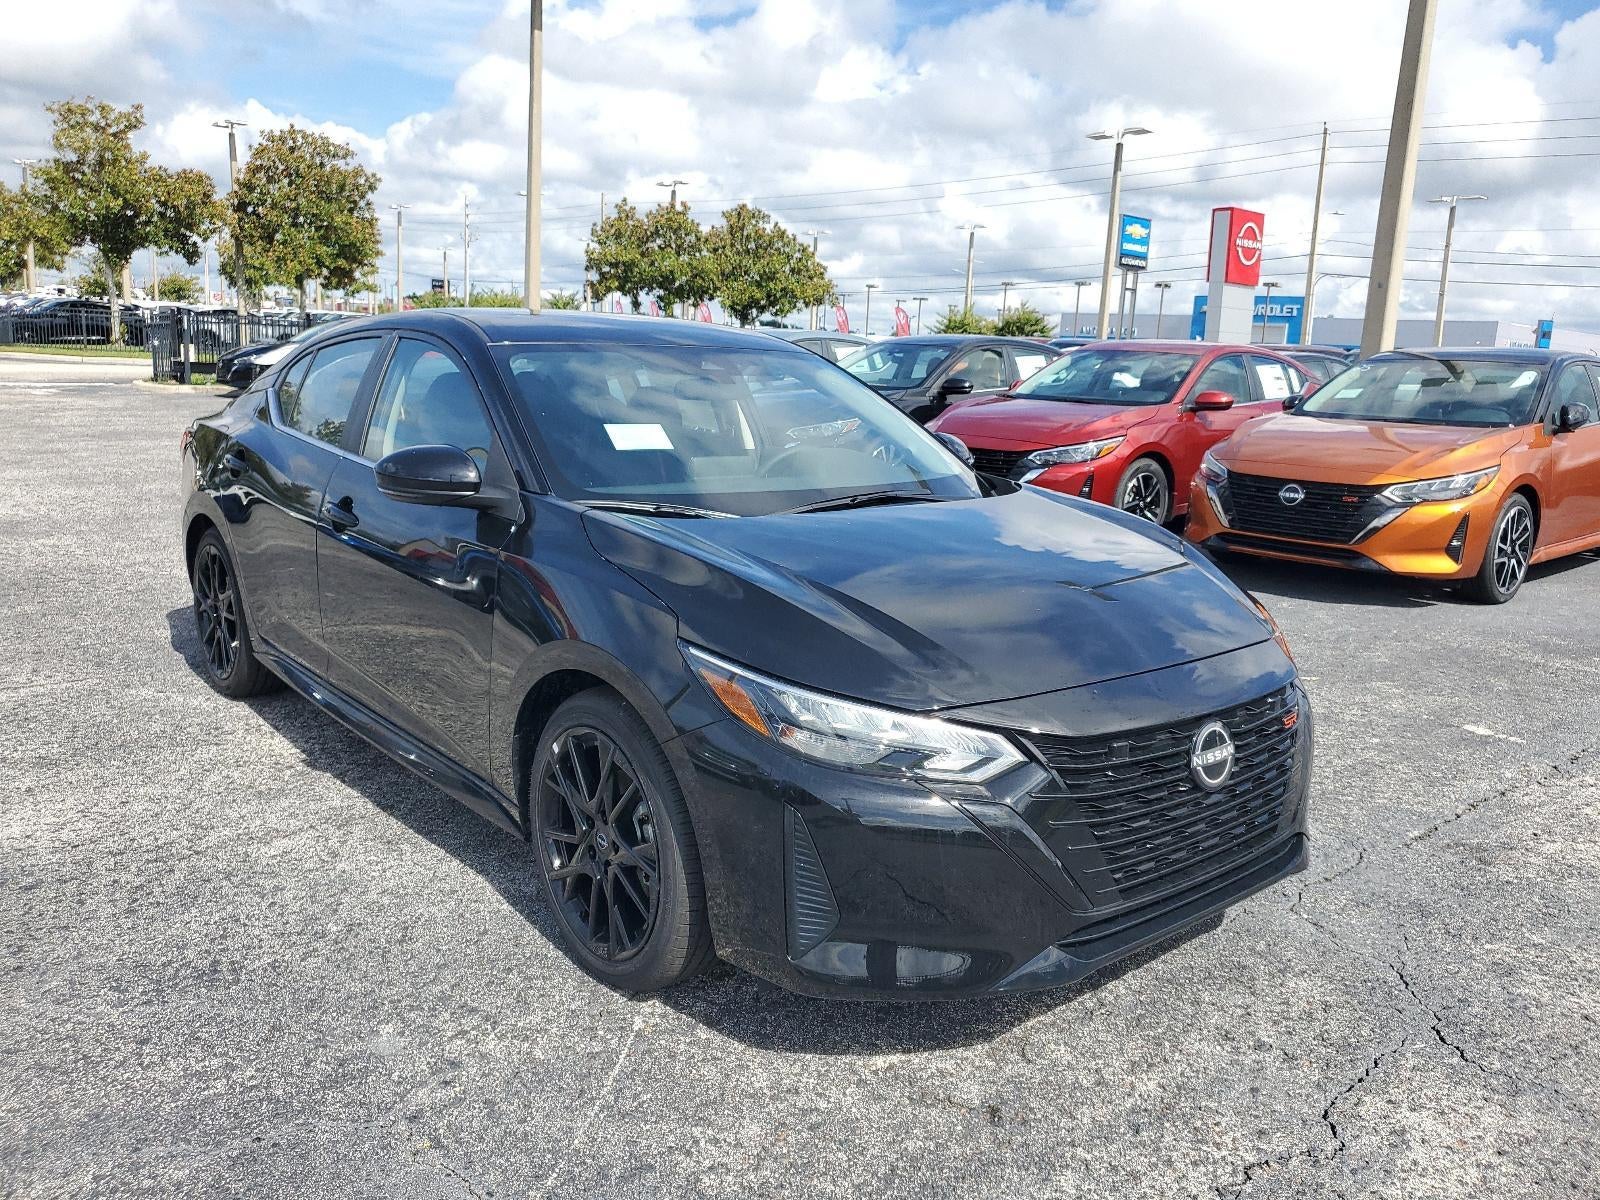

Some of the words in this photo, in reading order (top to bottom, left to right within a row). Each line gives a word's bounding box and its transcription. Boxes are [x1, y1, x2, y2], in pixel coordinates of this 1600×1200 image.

[1236, 237, 1262, 250] NISSAN
[1252, 303, 1301, 317] VROLET
[1282, 711, 1297, 729] SR
[1193, 743, 1234, 768] NISSAN
